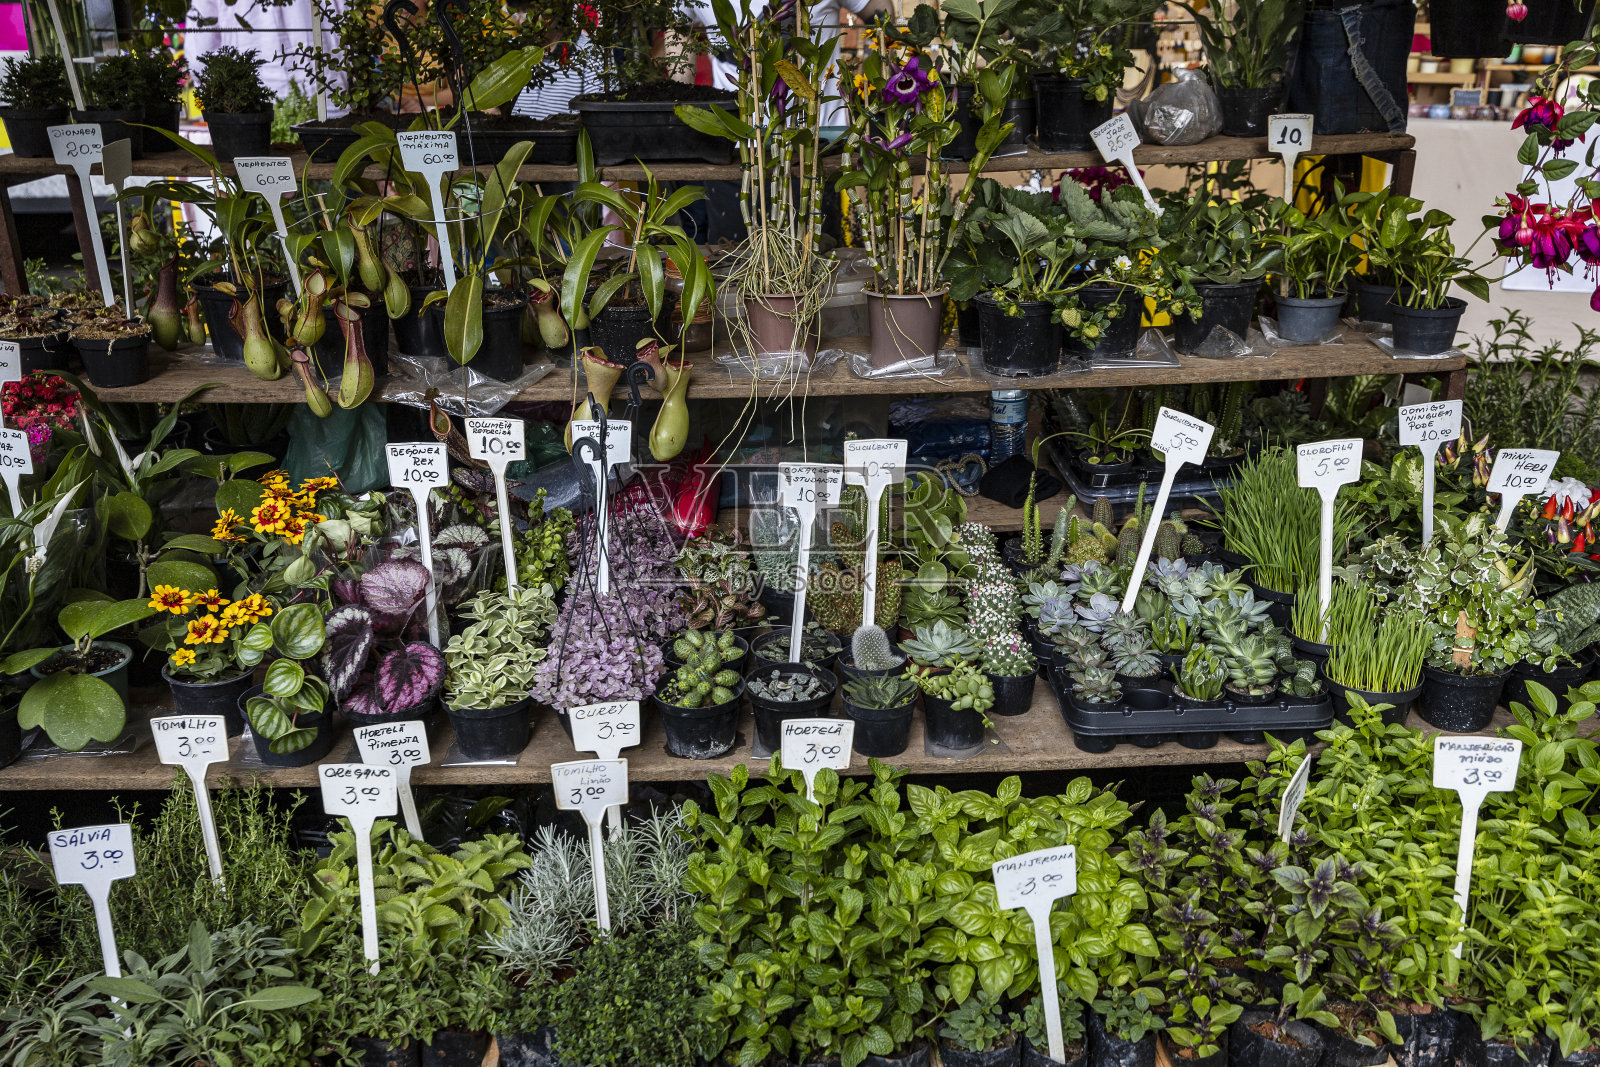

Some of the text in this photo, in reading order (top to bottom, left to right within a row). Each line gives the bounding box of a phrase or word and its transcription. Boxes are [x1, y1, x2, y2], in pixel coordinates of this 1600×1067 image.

[1106, 124, 1126, 139] JADE
[1407, 420, 1435, 431] PODE
[1299, 442, 1354, 456] CLOROFILA
[412, 457, 434, 466] REX
[1514, 460, 1548, 473] HERA
[154, 718, 217, 731] TOMILHO
[785, 723, 844, 736] HORTELÃ
[360, 724, 406, 739] HORTELÃ
[368, 735, 420, 751] PIMENTA
[555, 764, 607, 777] TOMILHO
[54, 829, 111, 848] SÁLVIA
[996, 852, 1074, 874] MANJERONA
